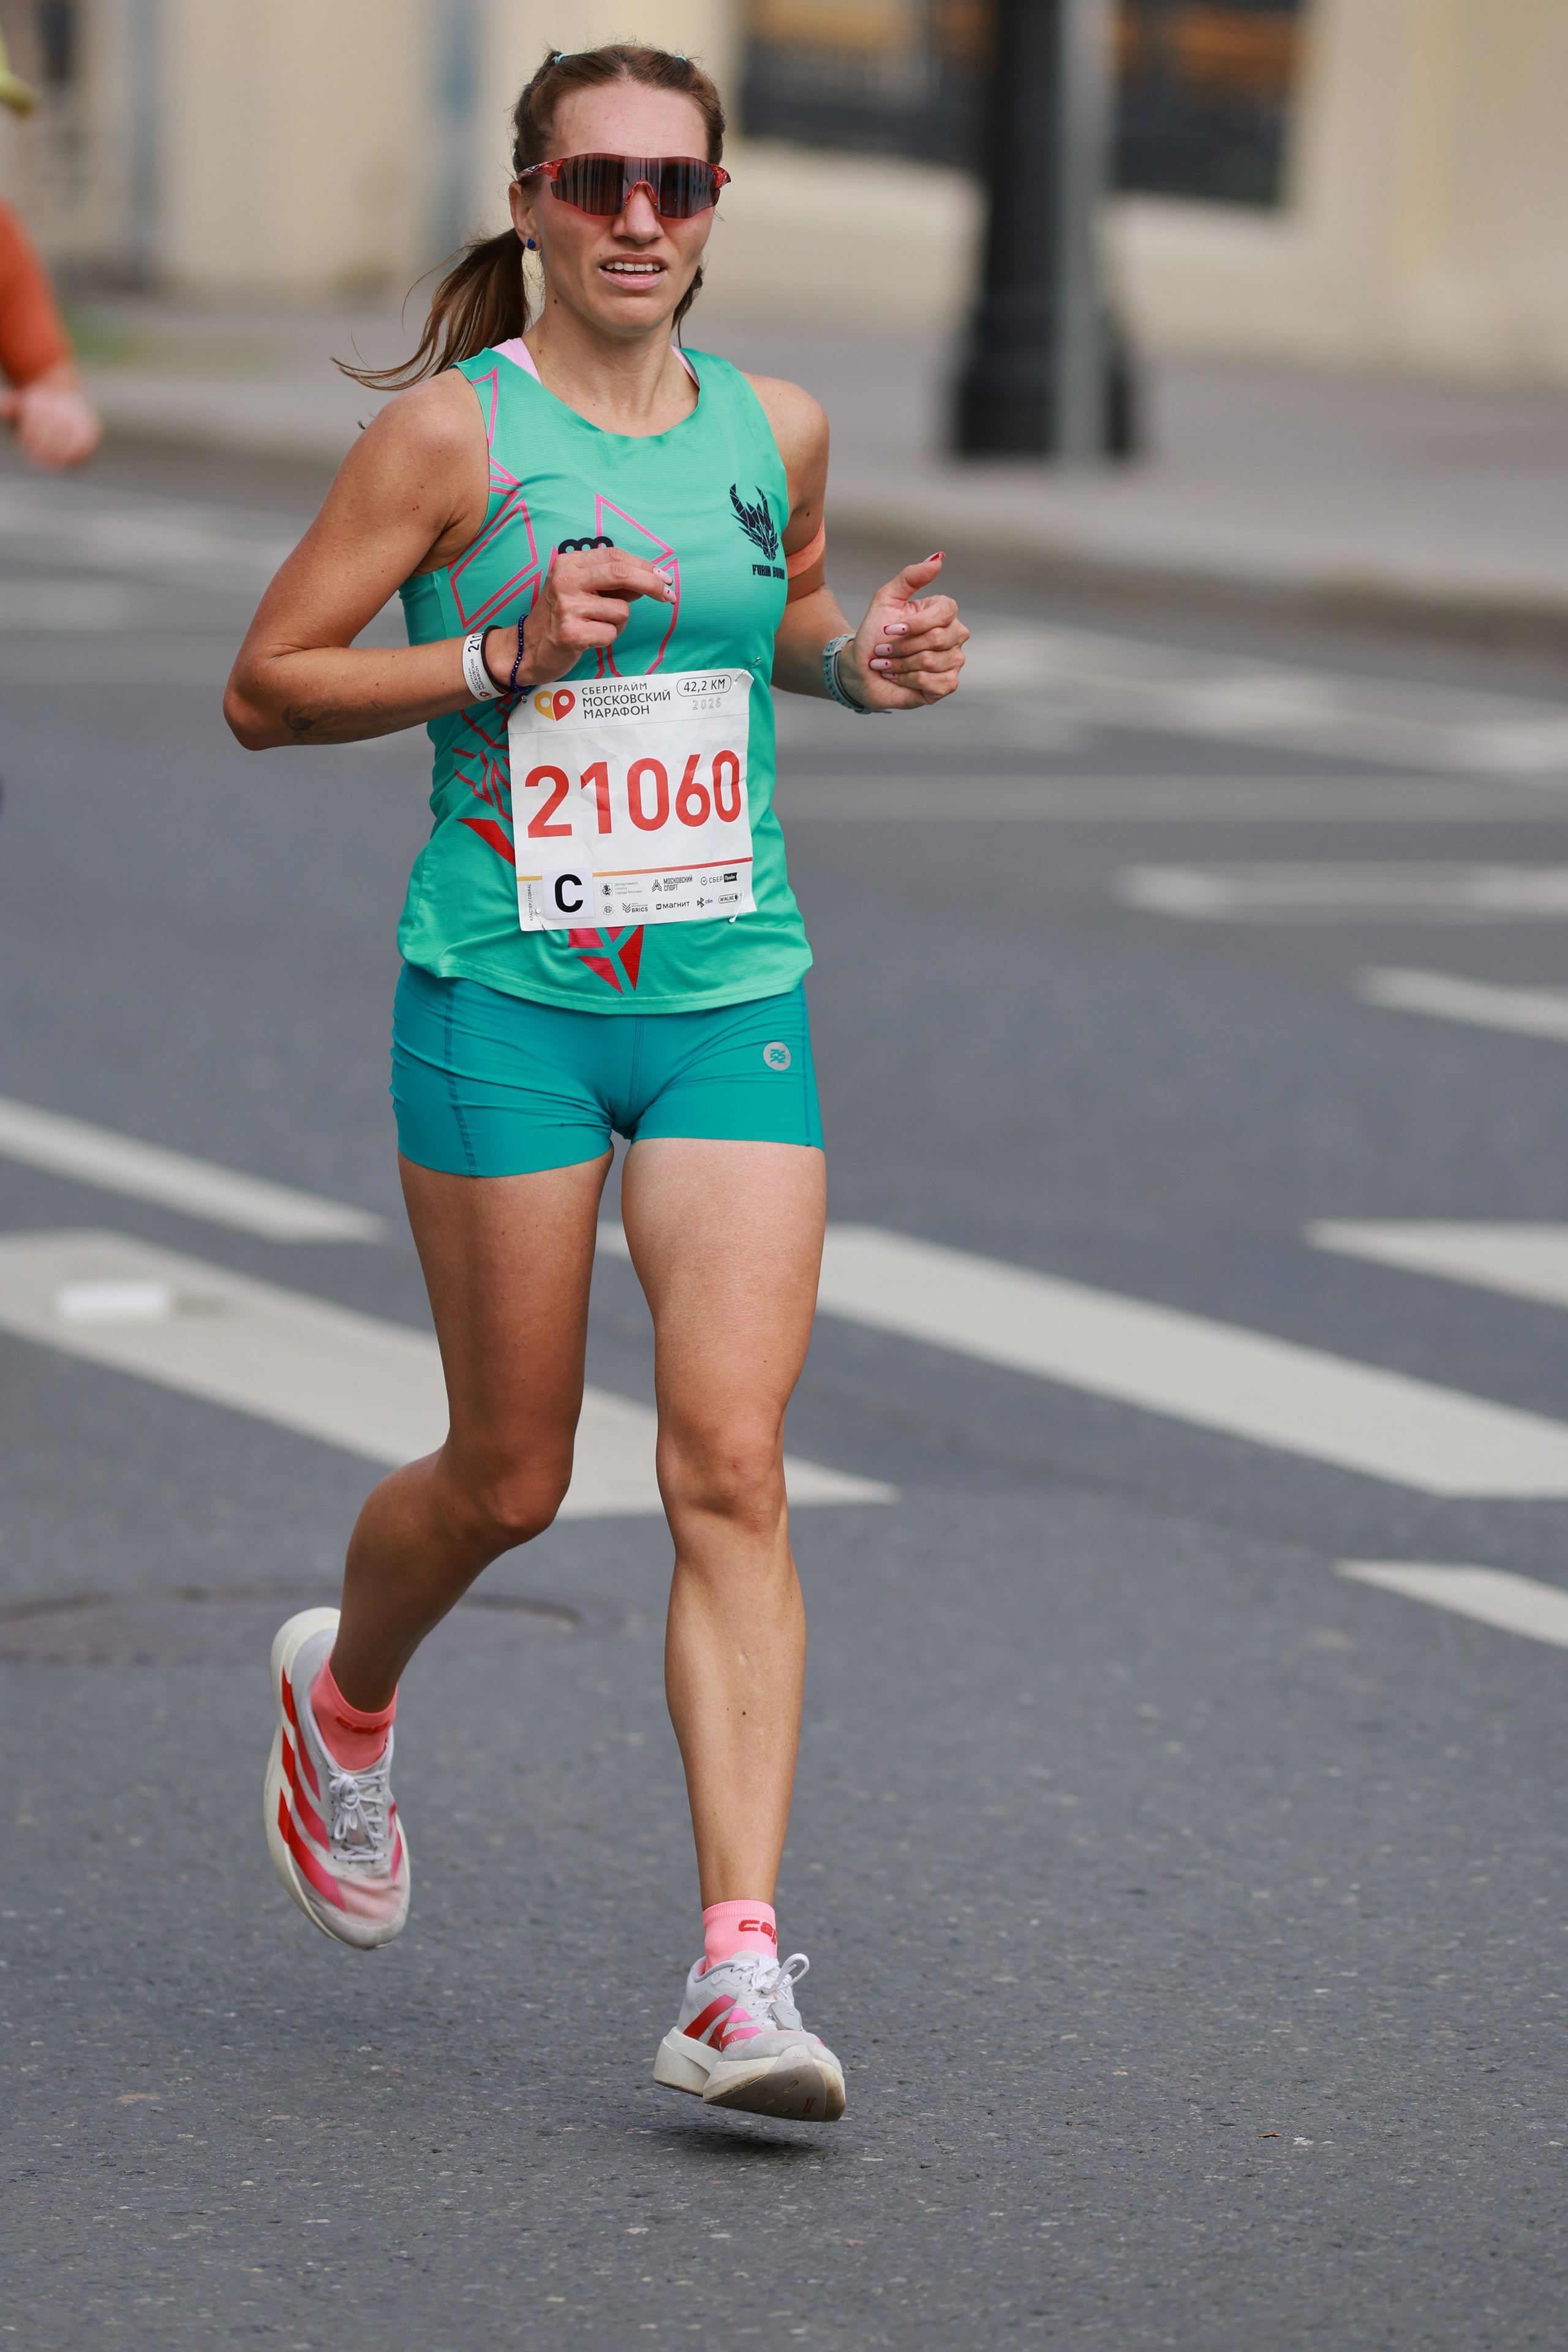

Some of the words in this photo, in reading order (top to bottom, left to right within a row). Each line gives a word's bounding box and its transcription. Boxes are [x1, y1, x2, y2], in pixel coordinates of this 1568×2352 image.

[470, 658, 482, 690] МОСКОВСКИЙ
[476, 666, 486, 689] МАРАФОН
[582, 683, 647, 695] СБЕРПРАЙМ
[684, 680, 707, 693] 42,2
[582, 690, 671, 707] МОСКОВСКИЙ
[692, 698, 722, 710] 2026
[584, 705, 650, 719] МАРАФОН
[525, 750, 741, 839] 21060
[663, 875, 693, 884] МОСКОВСКИЙ
